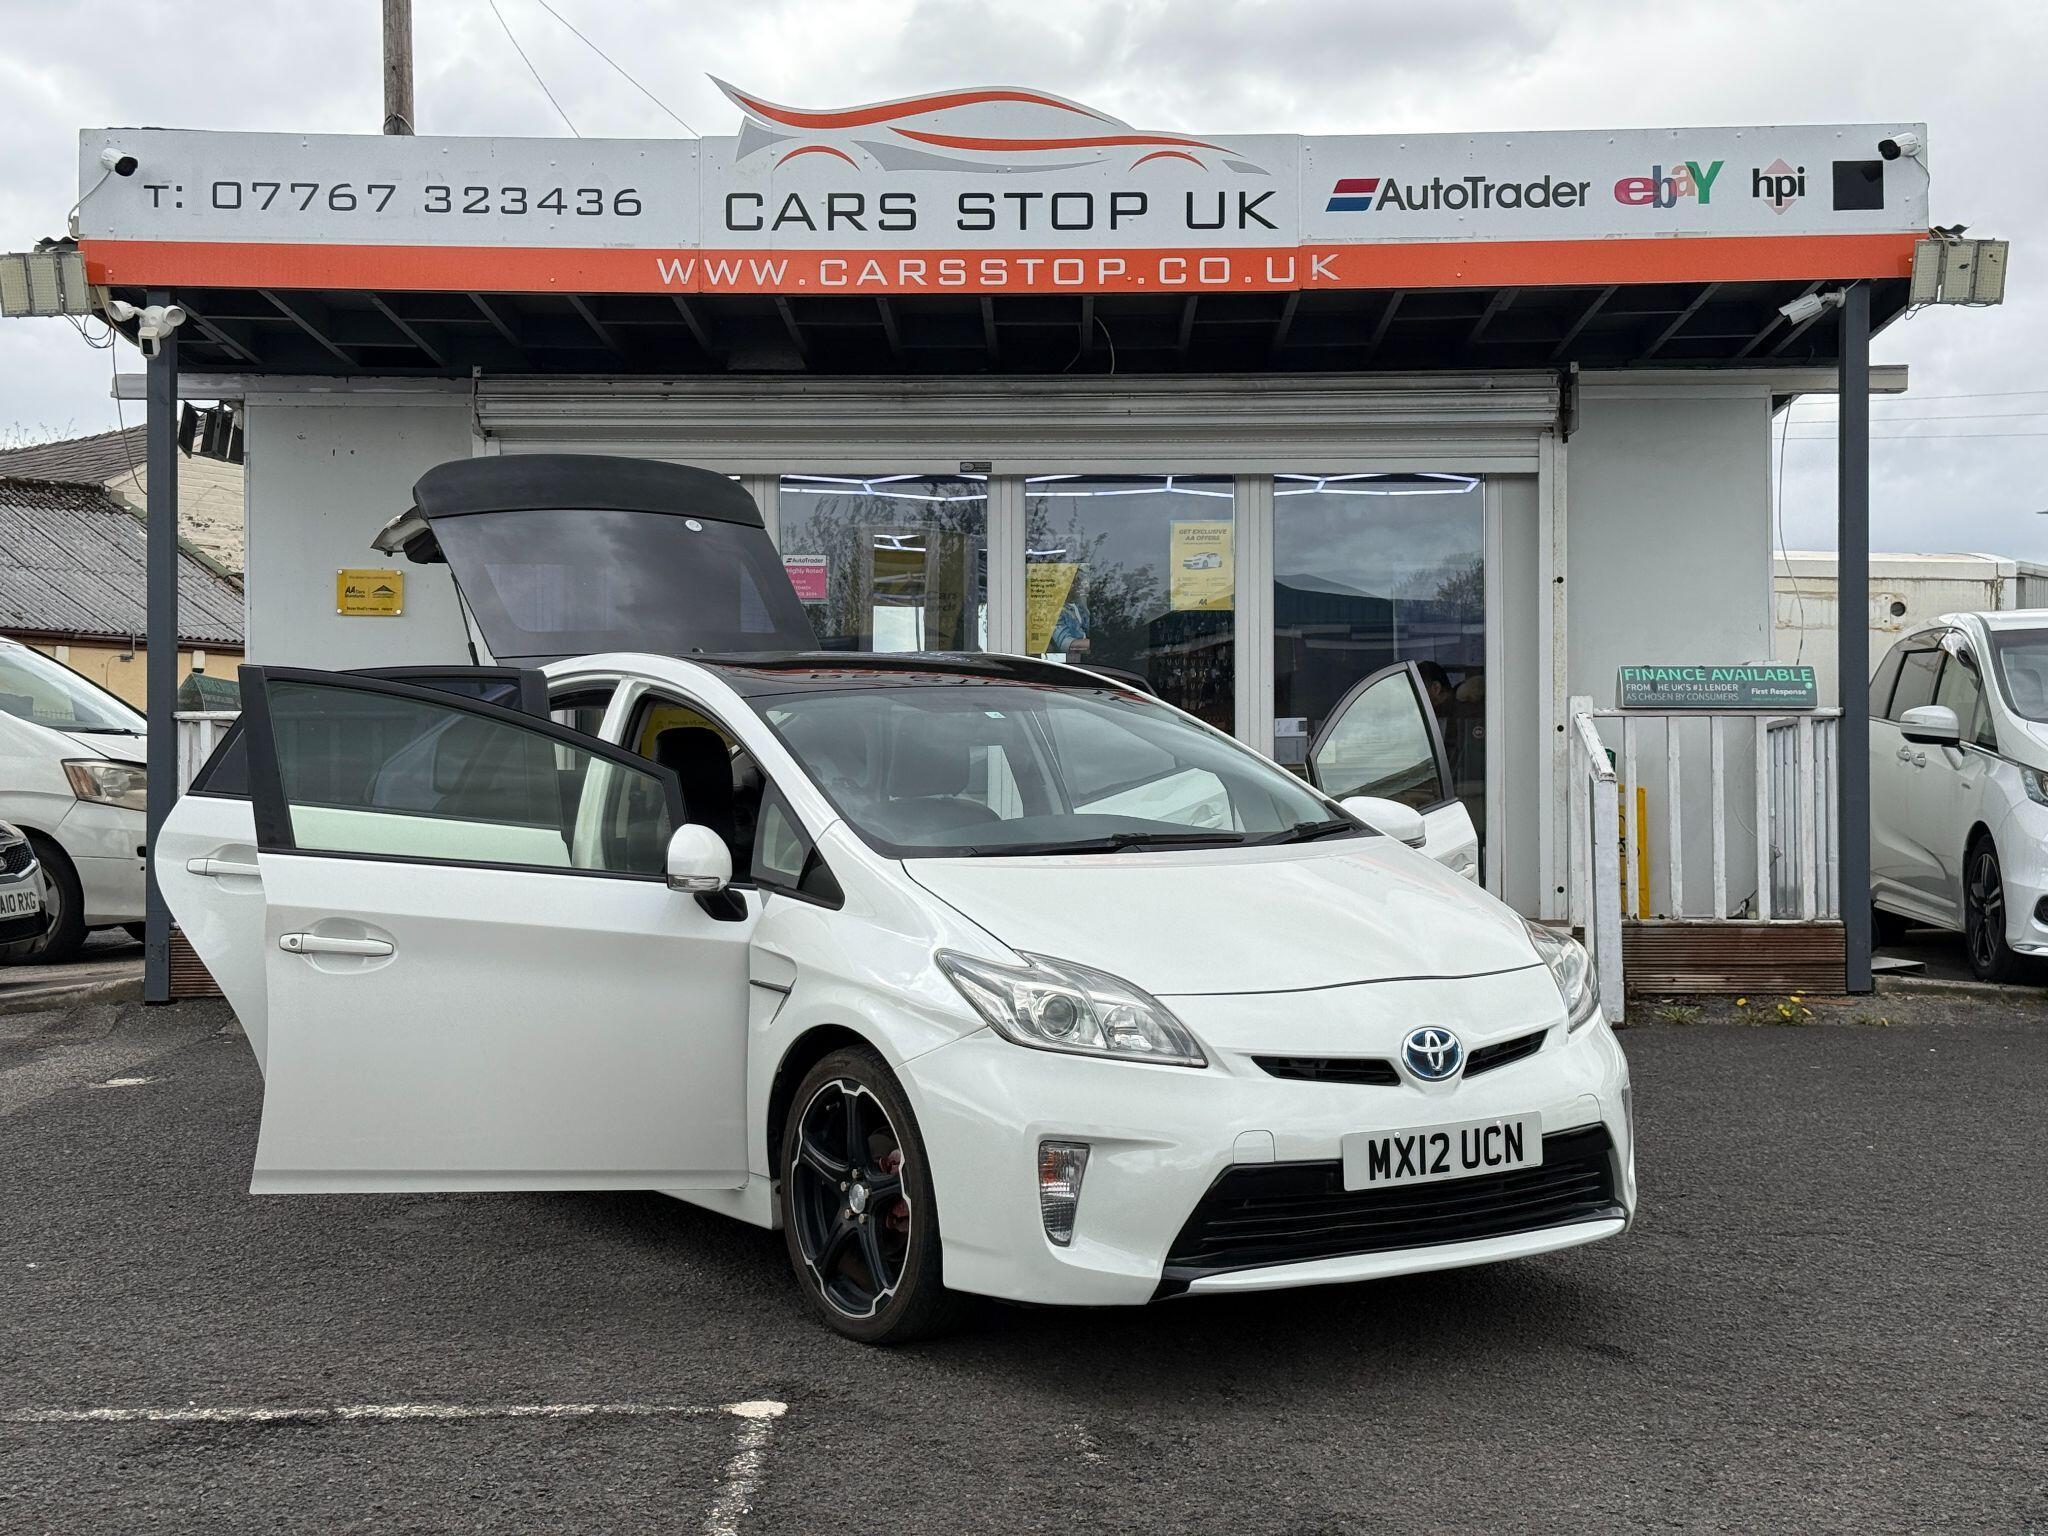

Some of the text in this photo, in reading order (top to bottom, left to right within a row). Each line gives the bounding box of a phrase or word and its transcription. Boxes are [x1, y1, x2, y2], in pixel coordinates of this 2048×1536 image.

[143, 181, 642, 217] T: 07767 323436
[1375, 174, 1591, 211] AutoTrader
[1752, 166, 1806, 206] hpi
[725, 190, 1280, 232] CARS STOP UK
[656, 254, 1341, 287] WWW.CARSSTOP.CO.UK
[345, 586, 356, 594] AA
[1624, 668, 1812, 682] FINANCE AVAILABLE
[1626, 683, 1651, 691] FROM
[1671, 683, 1692, 691] UK'S
[1693, 683, 1703, 691] #1
[1704, 683, 1739, 691] LENDER
[1626, 692, 1740, 701] AS CHOSEN BY CONSUMERS
[1751, 687, 1807, 697] First Response
[17, 891, 36, 911] RXG
[1368, 1121, 1524, 1181] MX12 UCN
